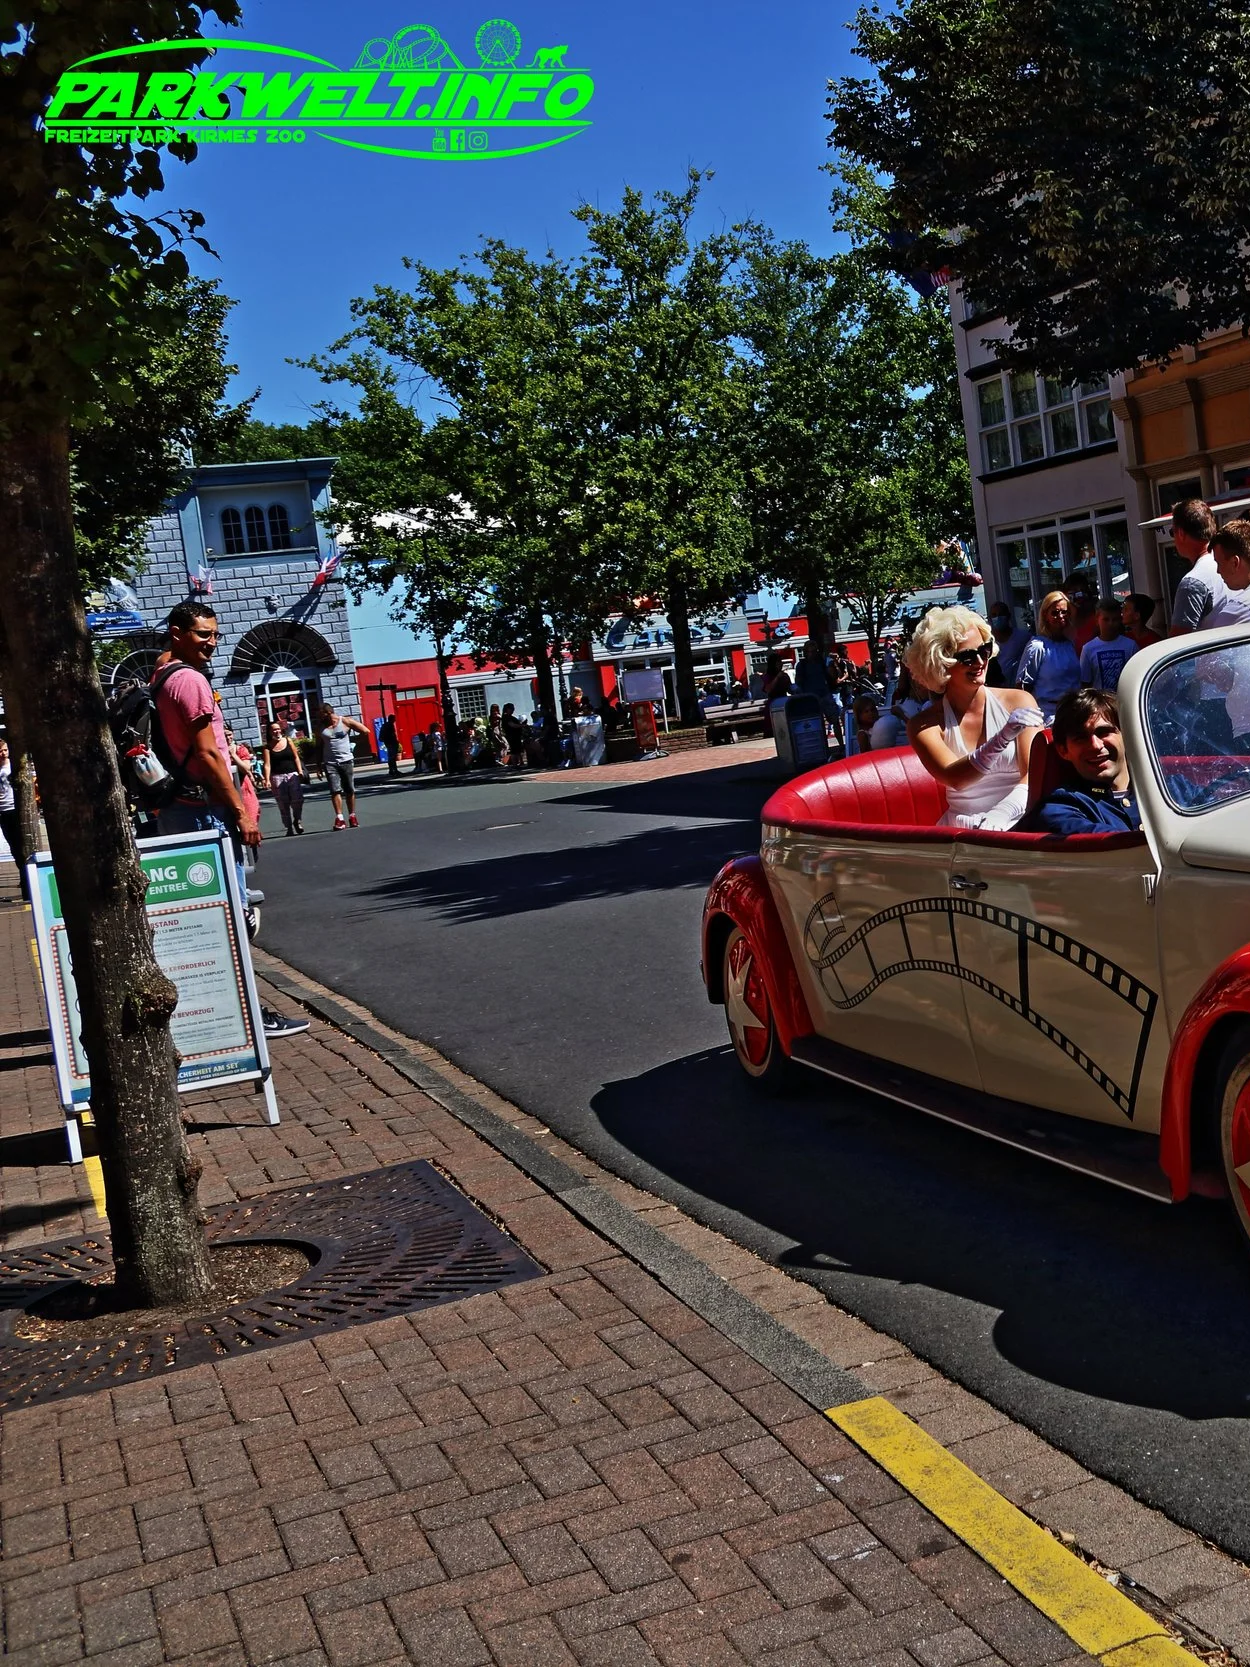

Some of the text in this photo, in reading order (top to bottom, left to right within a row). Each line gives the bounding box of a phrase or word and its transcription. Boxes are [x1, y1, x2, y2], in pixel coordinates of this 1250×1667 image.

[149, 882, 188, 895] ENTREE
[169, 960, 216, 972] ERFORDERLICH
[177, 1007, 215, 1019] BEVORZUGT
[213, 1065, 225, 1073] AM
[226, 1062, 239, 1070] SET
